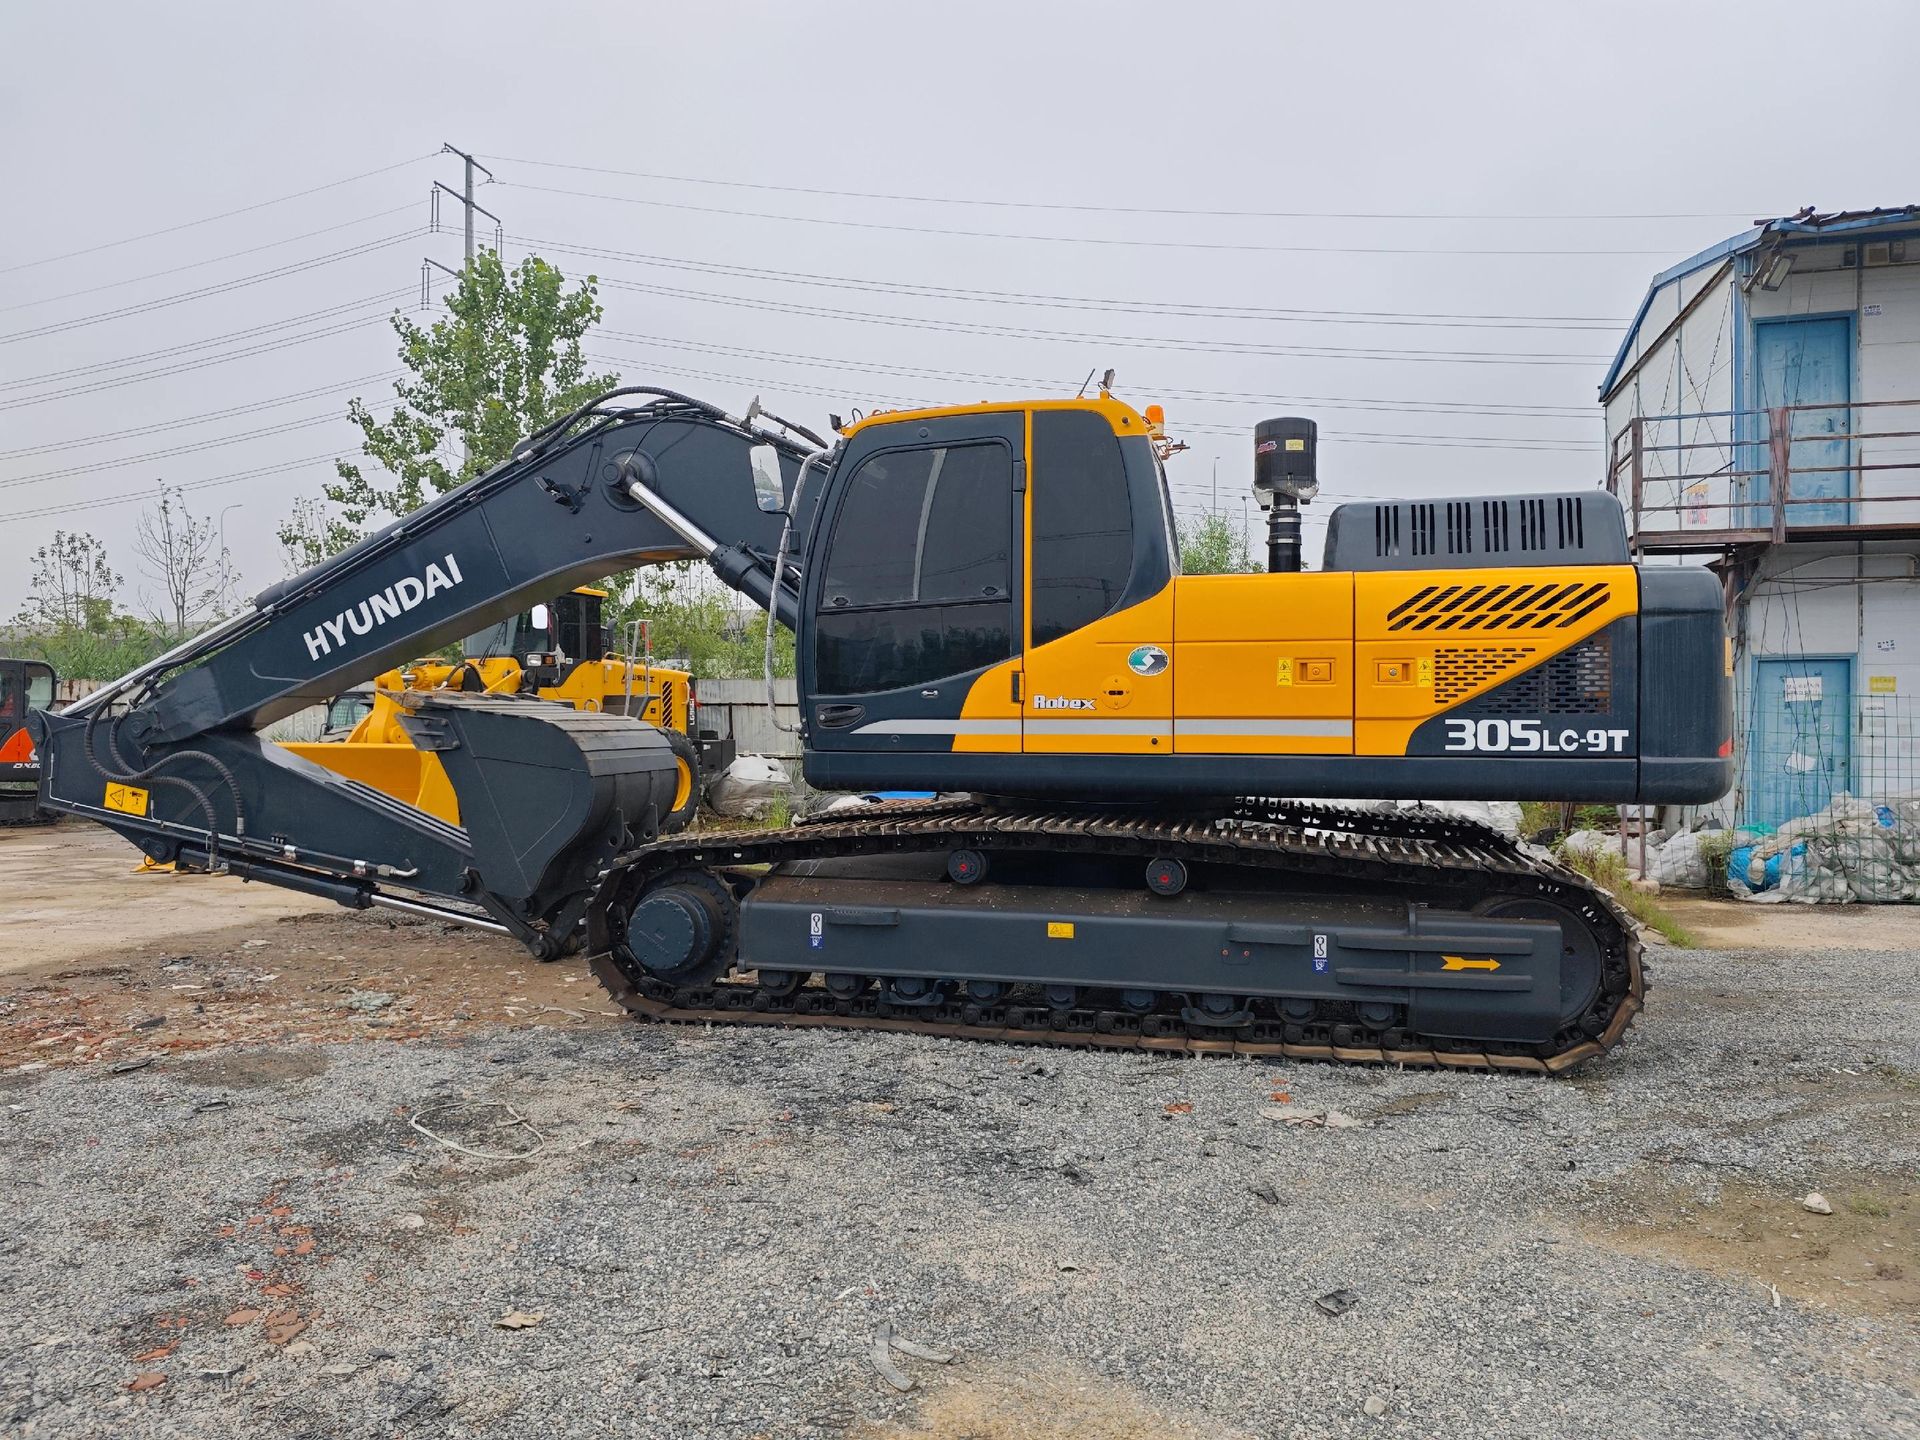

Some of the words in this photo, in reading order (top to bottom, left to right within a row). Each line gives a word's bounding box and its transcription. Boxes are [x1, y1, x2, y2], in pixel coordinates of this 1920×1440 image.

[303, 553, 464, 662] HYUNDAI
[1033, 695, 1096, 710] Robex
[1444, 719, 1630, 752] 305LC-9T
